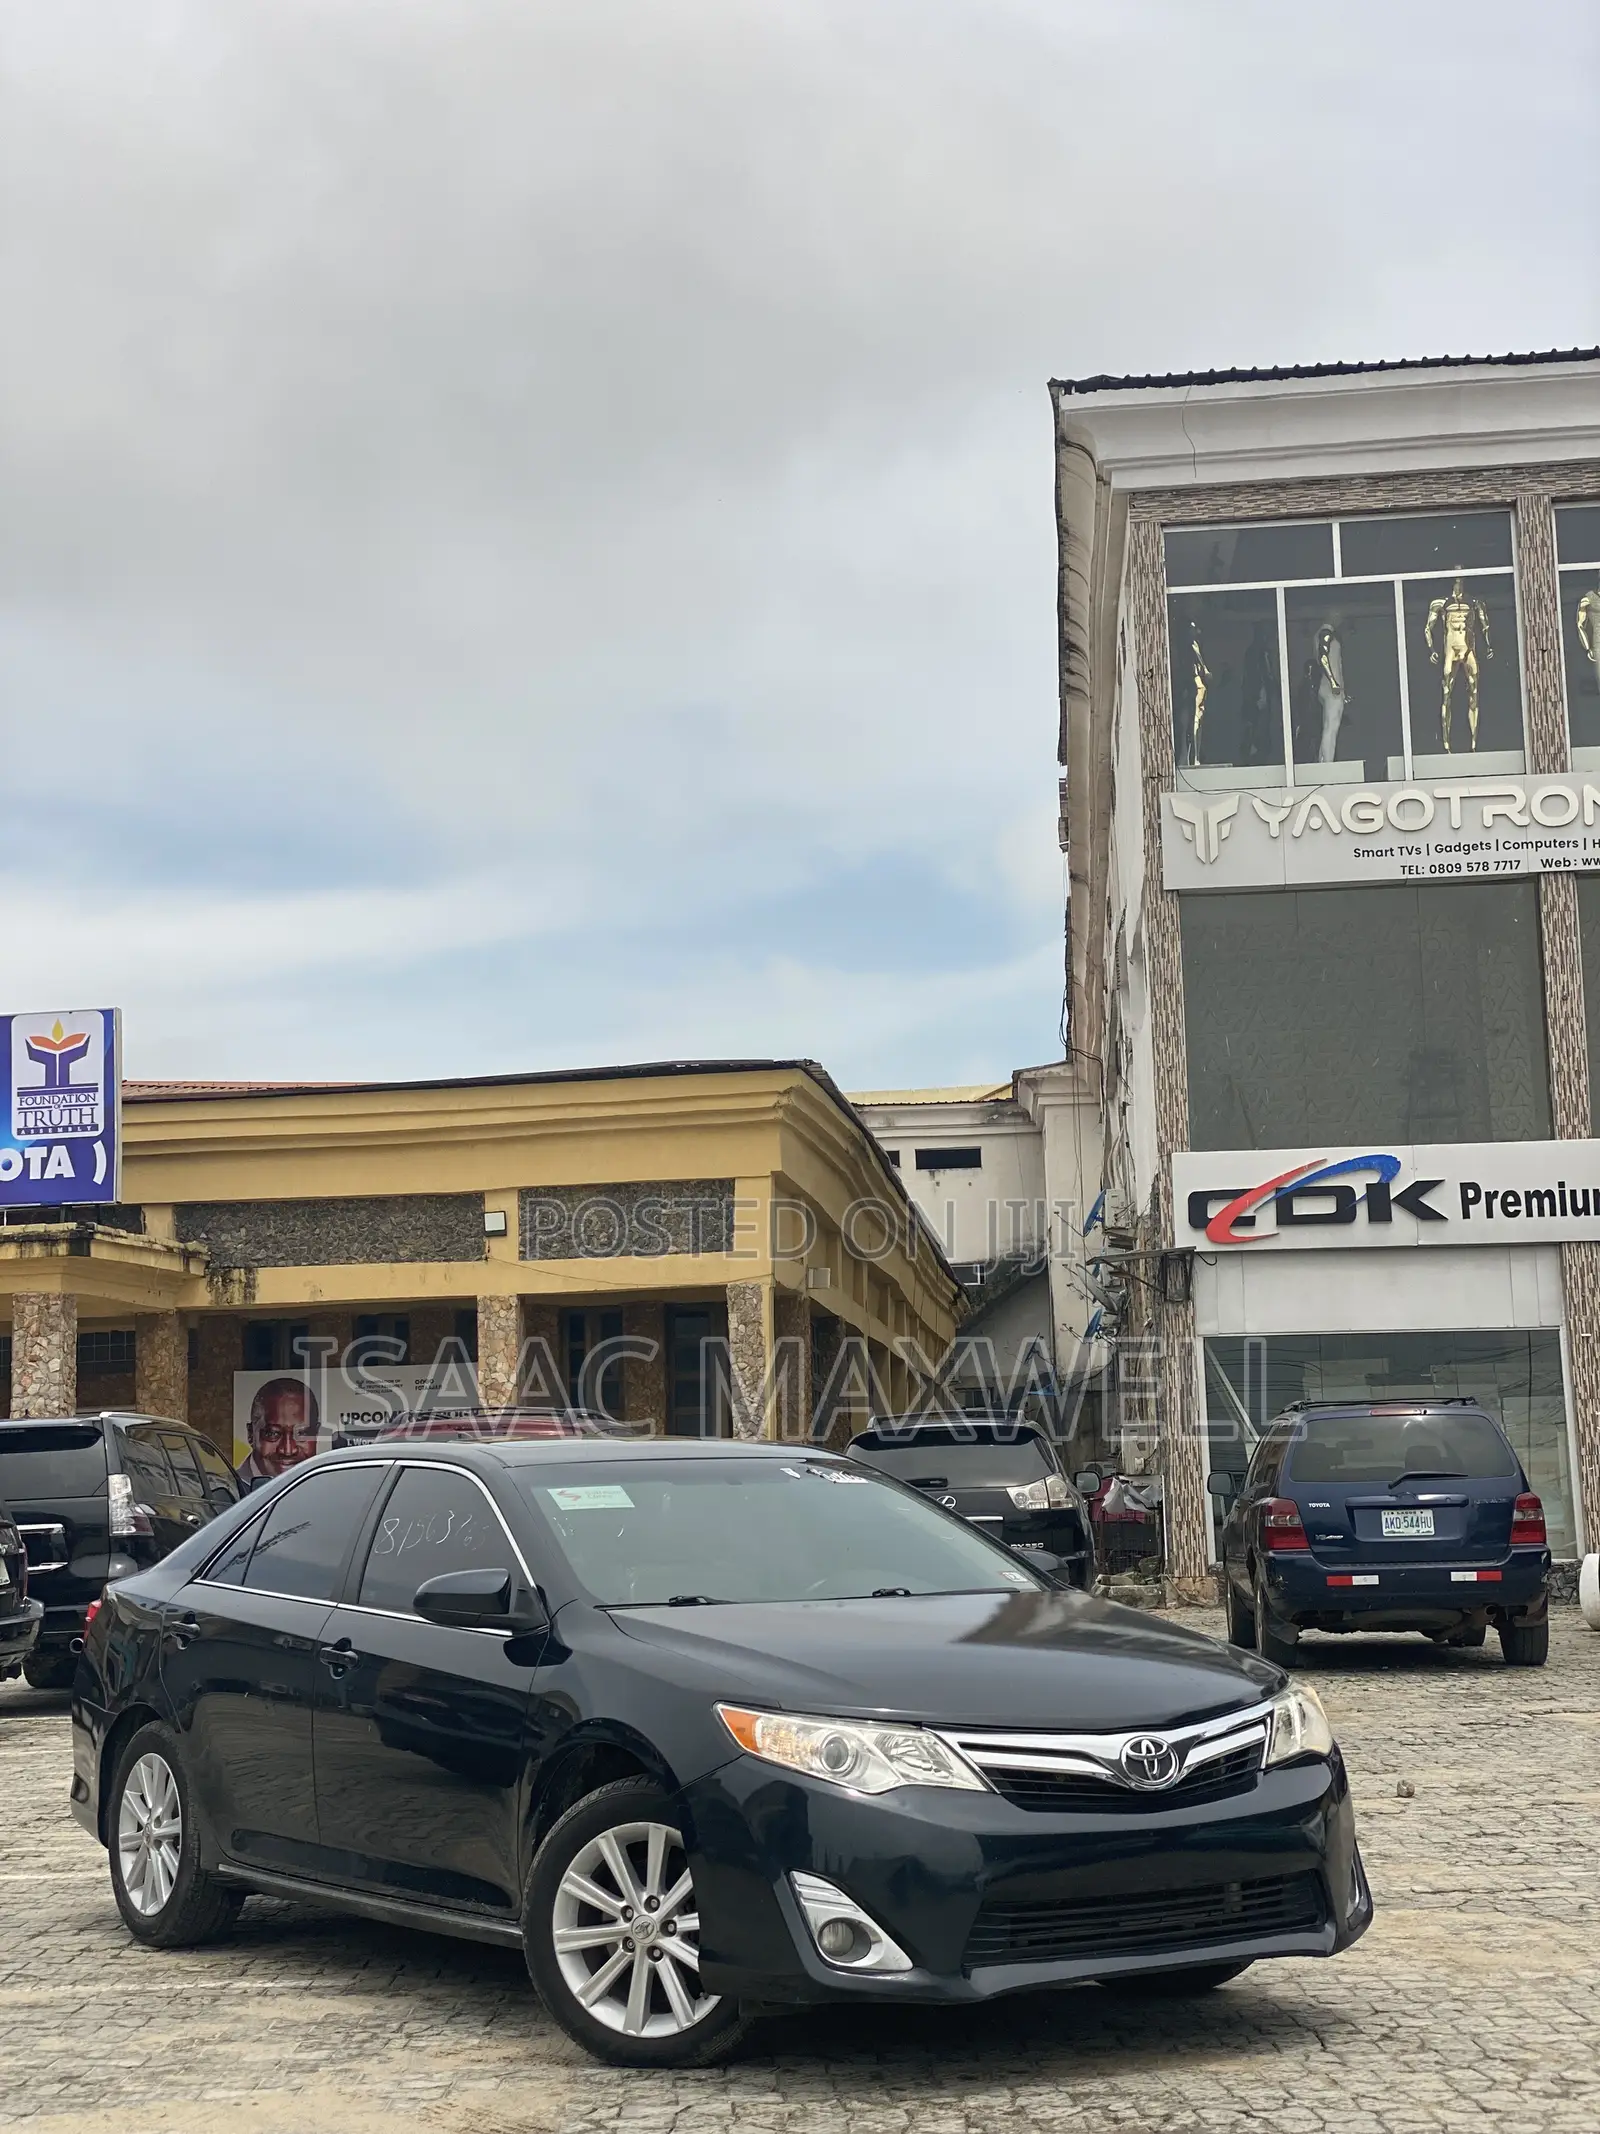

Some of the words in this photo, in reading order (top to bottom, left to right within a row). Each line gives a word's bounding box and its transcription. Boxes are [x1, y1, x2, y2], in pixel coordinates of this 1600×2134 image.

[1354, 848, 1394, 858] Smart
[1398, 846, 1422, 856] TVs
[1435, 841, 1491, 855] Gadgets
[1502, 839, 1579, 852] Computers
[1400, 865, 1425, 875] TEL:
[1429, 863, 1462, 874] 0809
[1466, 861, 1489, 872] 578
[1494, 860, 1520, 871] 7717
[20, 1093, 96, 1106] FOUNDATION
[18, 1107, 94, 1128] TRUTH
[21, 1126, 92, 1135] ASSEMBLY
